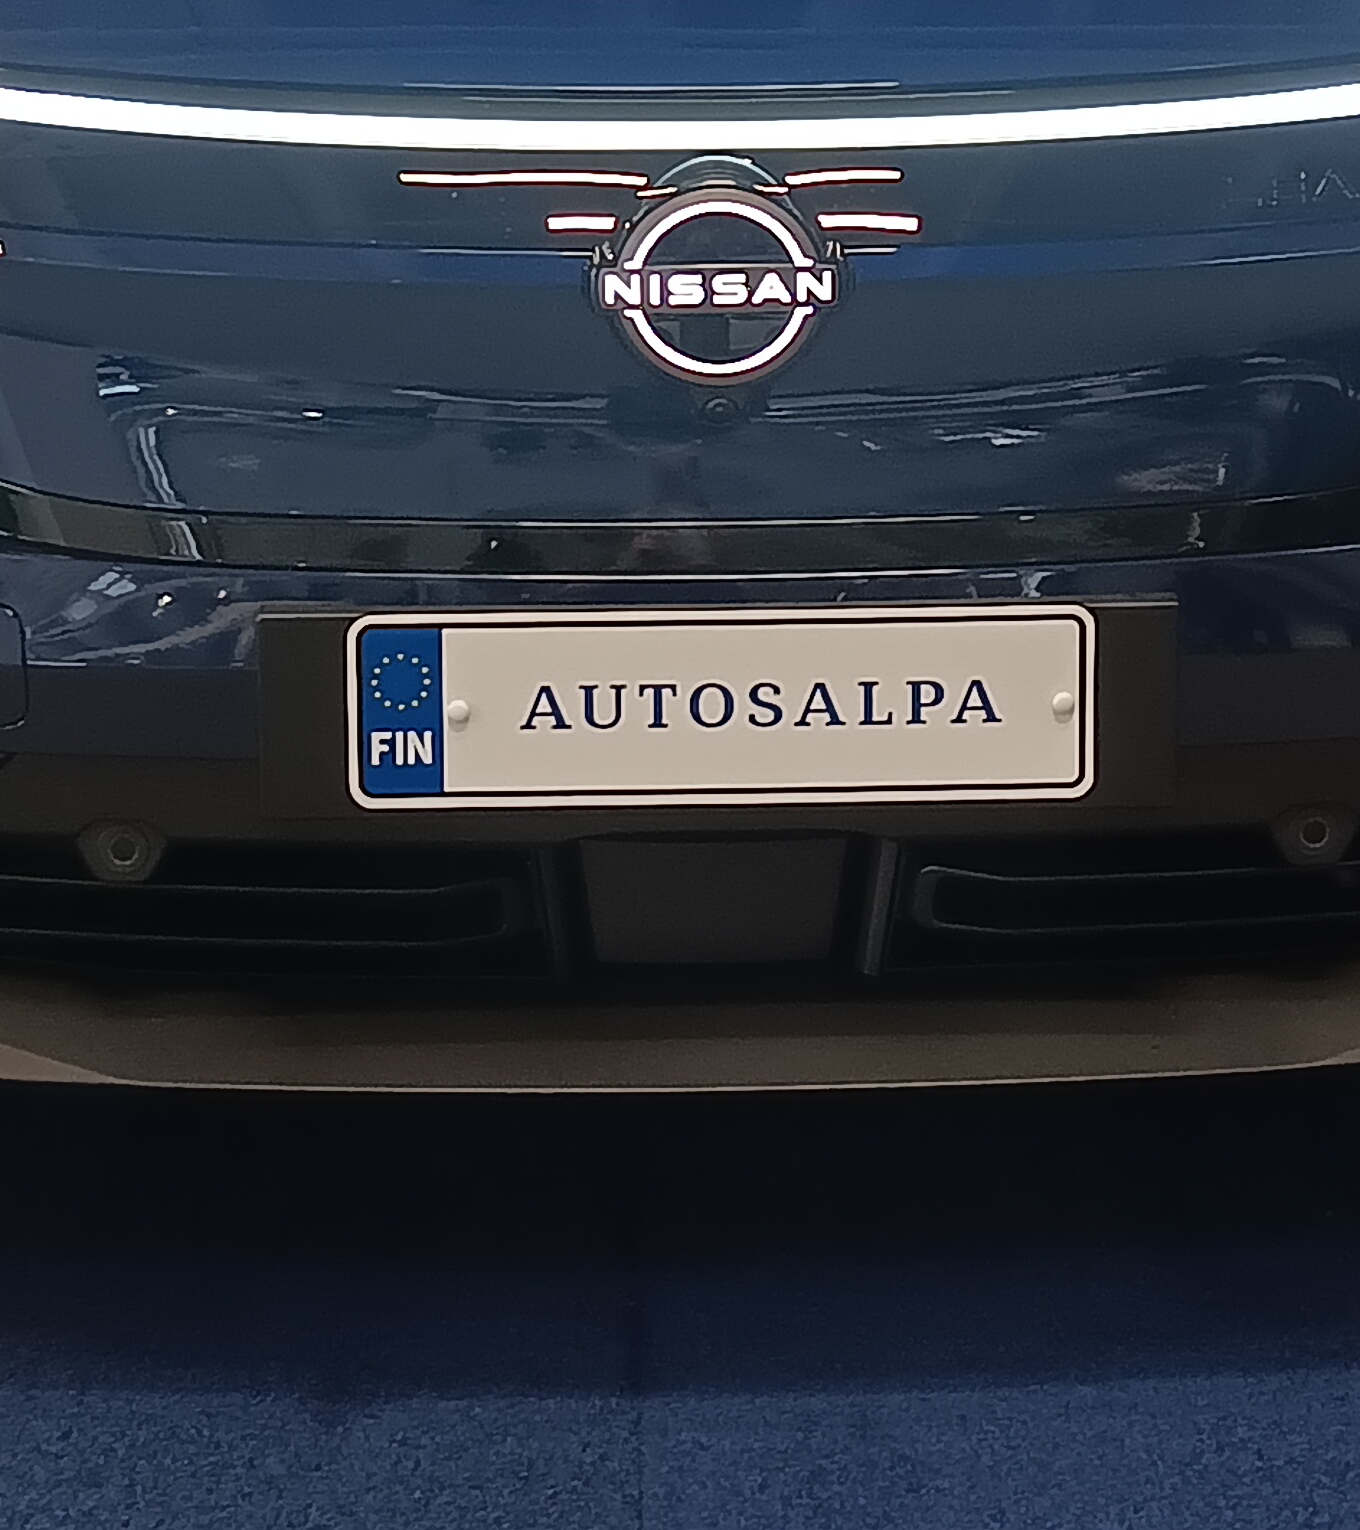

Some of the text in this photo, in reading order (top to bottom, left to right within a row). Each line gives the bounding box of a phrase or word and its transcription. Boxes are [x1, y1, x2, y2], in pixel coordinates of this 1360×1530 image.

[603, 270, 834, 306] NISSAN
[518, 678, 1004, 732] AUTOSALPA
[369, 729, 434, 767] FIN
